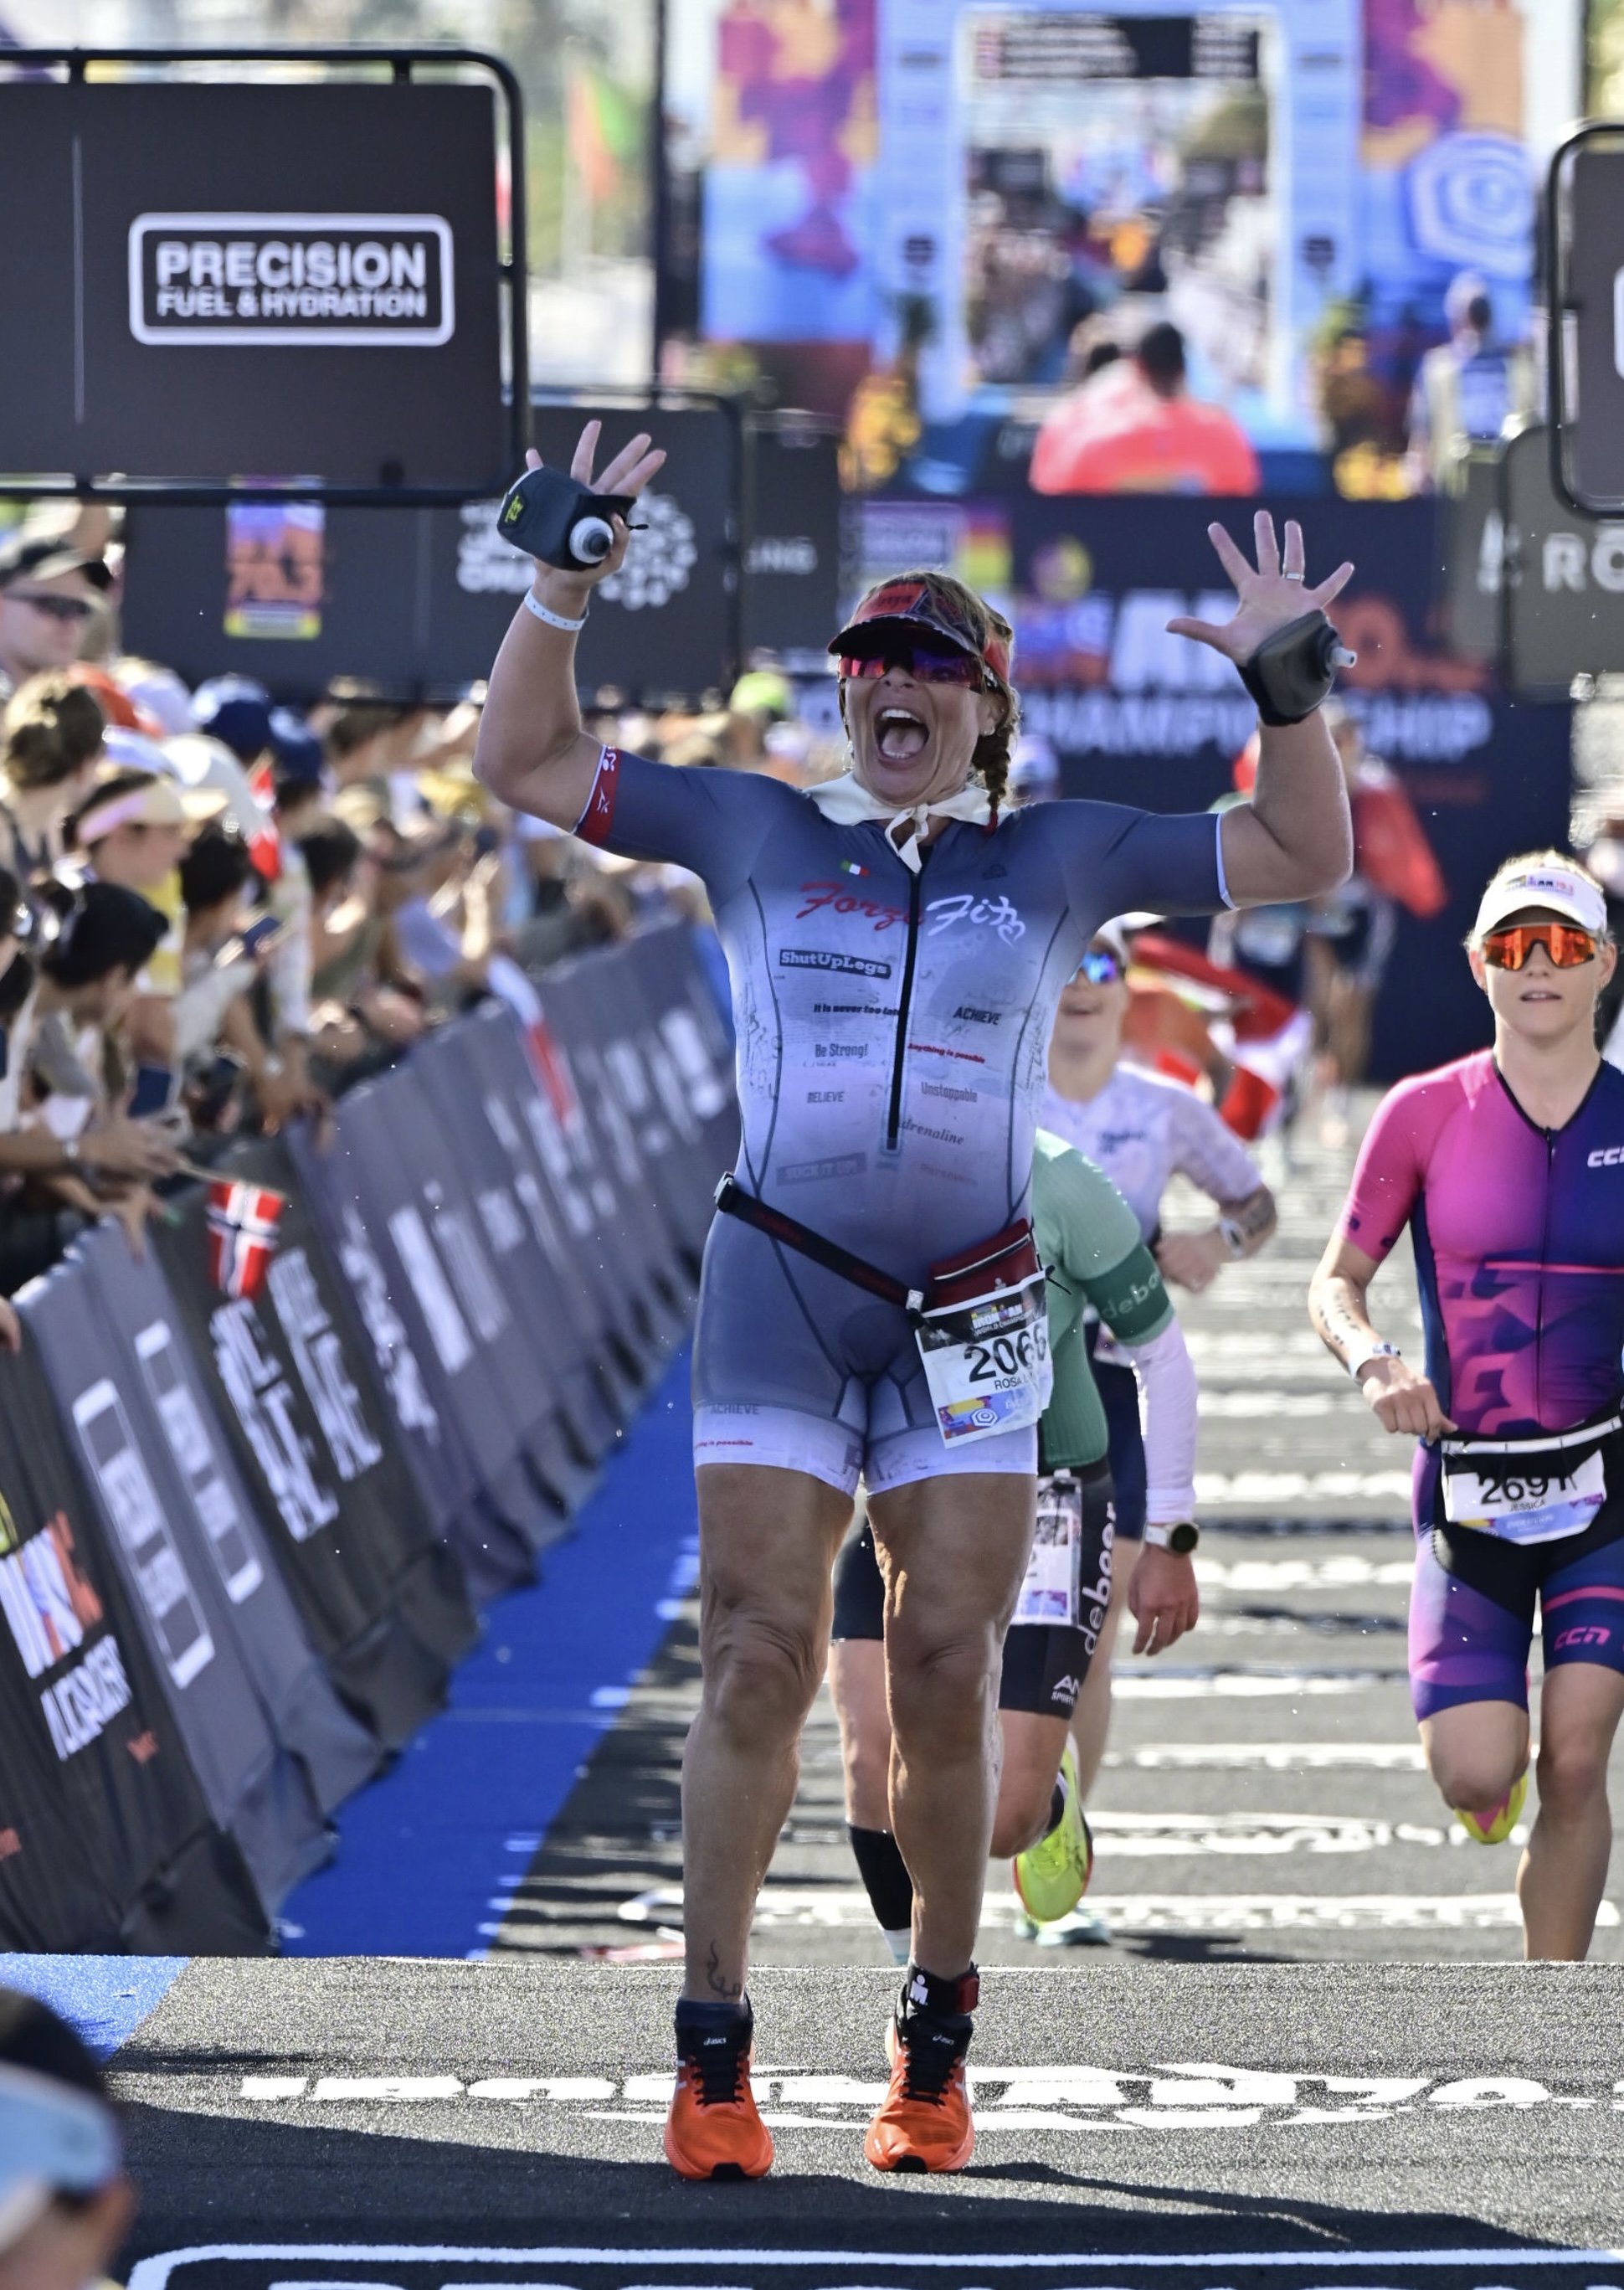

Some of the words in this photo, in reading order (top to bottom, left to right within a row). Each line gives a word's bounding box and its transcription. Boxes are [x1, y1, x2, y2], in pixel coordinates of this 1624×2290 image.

[157, 241, 425, 288] PRECISION
[157, 286, 233, 316] FUEL
[237, 286, 259, 316] &
[261, 286, 426, 317] HYDRATION
[780, 951, 888, 976] ShutUpLegs
[833, 1006, 862, 1014] never
[864, 1006, 881, 1015] too
[953, 1006, 1002, 1026] ACHIEVE
[815, 1044, 827, 1058] Be
[829, 1043, 869, 1058] Strong!
[907, 1042, 945, 1056] Anything
[954, 1052, 985, 1064] possible
[806, 1091, 845, 1104] BELIEVE
[921, 1081, 978, 1103] Unstoppable
[899, 1119, 964, 1145] drenaline
[710, 1403, 760, 1415] ACHIEVE
